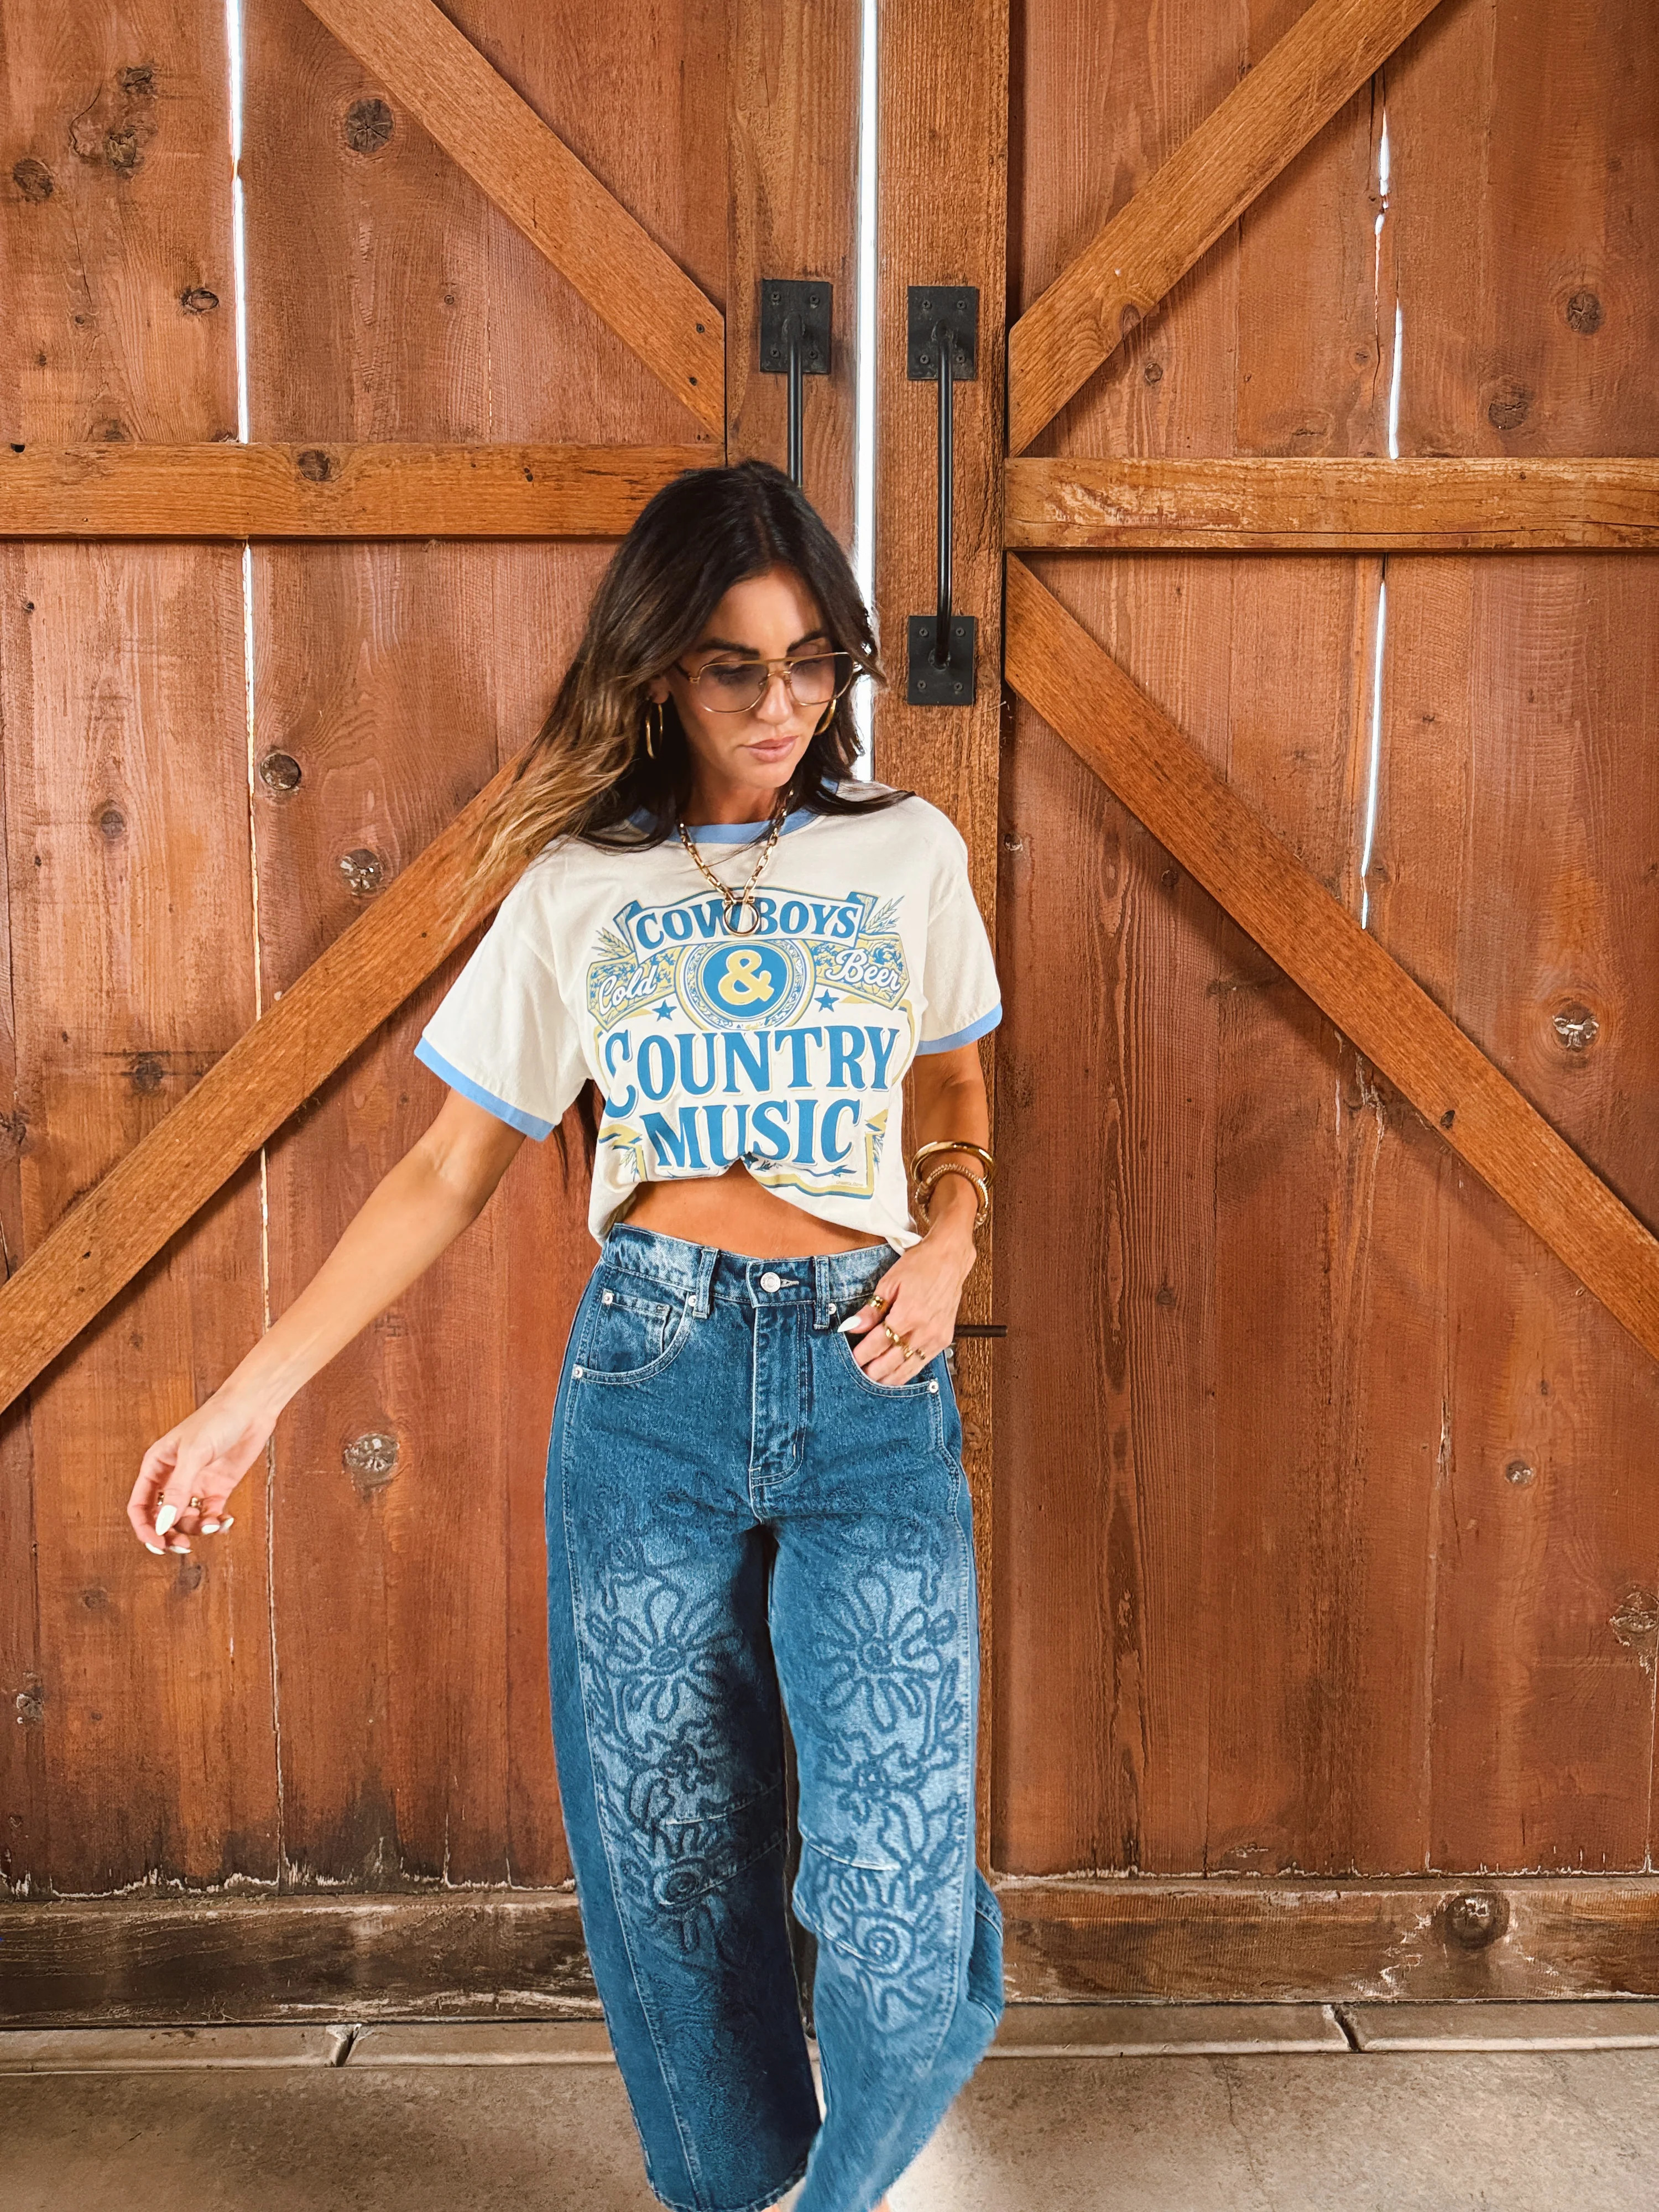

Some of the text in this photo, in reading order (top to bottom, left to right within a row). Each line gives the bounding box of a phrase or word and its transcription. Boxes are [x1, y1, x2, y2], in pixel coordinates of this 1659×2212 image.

[637, 897, 858, 950] COWBOYS
[599, 965, 658, 1015] Cold
[719, 949, 774, 1005] &
[826, 948, 900, 990] Beer
[604, 1026, 900, 1118] COUNTRY
[639, 1099, 860, 1168] MUSIC
